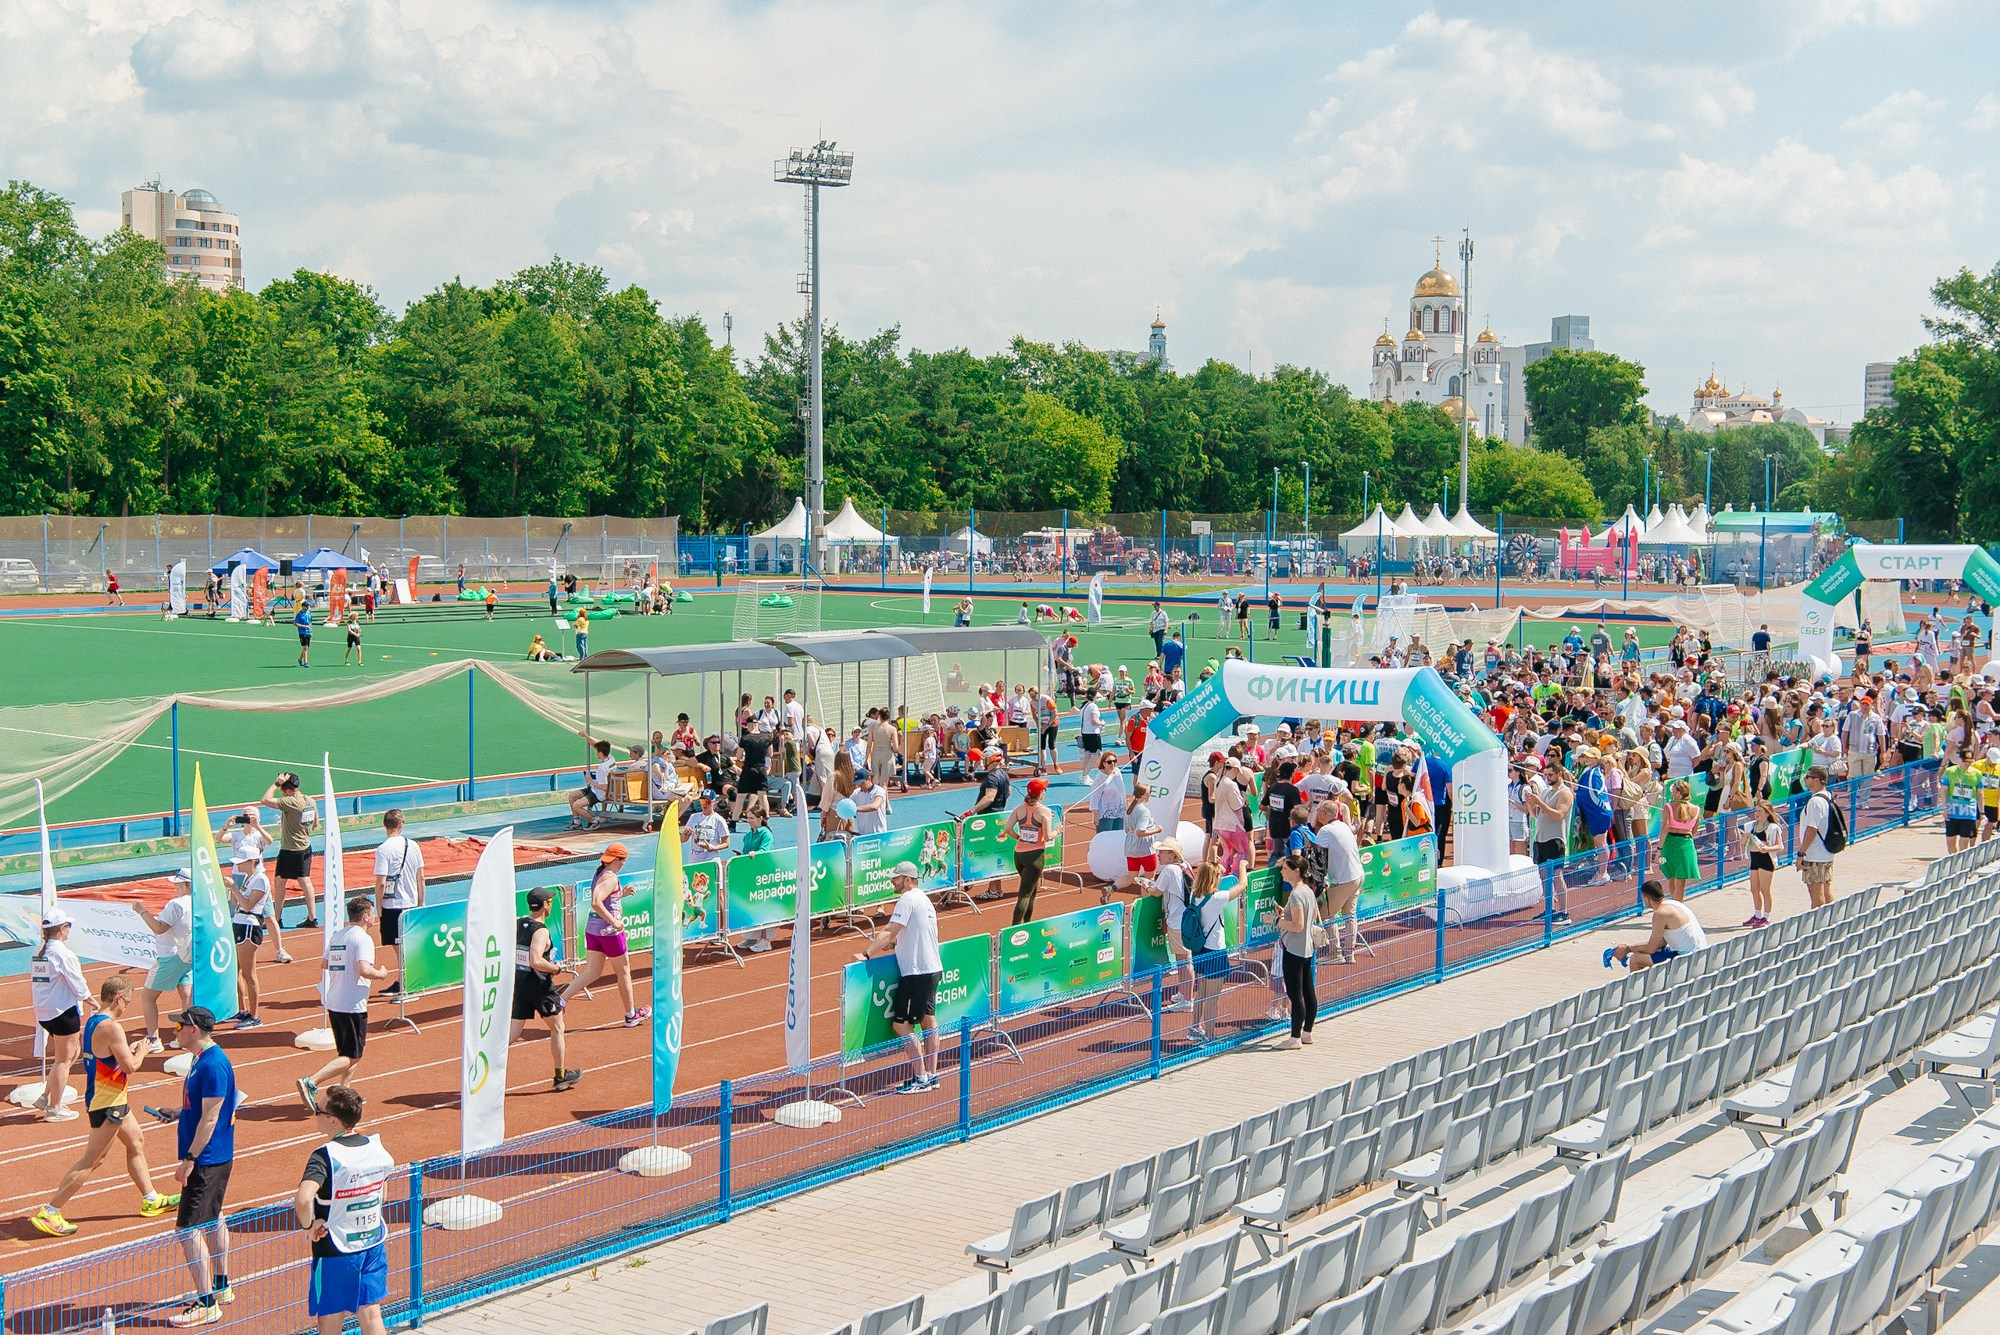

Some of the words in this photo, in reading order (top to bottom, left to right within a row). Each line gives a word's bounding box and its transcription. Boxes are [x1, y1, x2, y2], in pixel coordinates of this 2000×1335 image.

[1879, 556, 1943, 570] СТАРТ
[1800, 626, 1826, 636] СБЕР
[1247, 675, 1380, 705] ФИНИШ
[1164, 683, 1214, 728] зелёный
[1169, 693, 1221, 740] марафон
[1407, 704, 1456, 759] марафон
[1415, 695, 1466, 747] зелёный
[861, 858, 881, 870] БЕГИ
[756, 868, 797, 885] зелёны
[1255, 896, 1275, 910] БЕГИ
[621, 910, 650, 927] ОГАЙ
[671, 902, 681, 1001] СБЕР
[480, 934, 501, 1039] СБЕР
[355, 1212, 377, 1226] 1155
